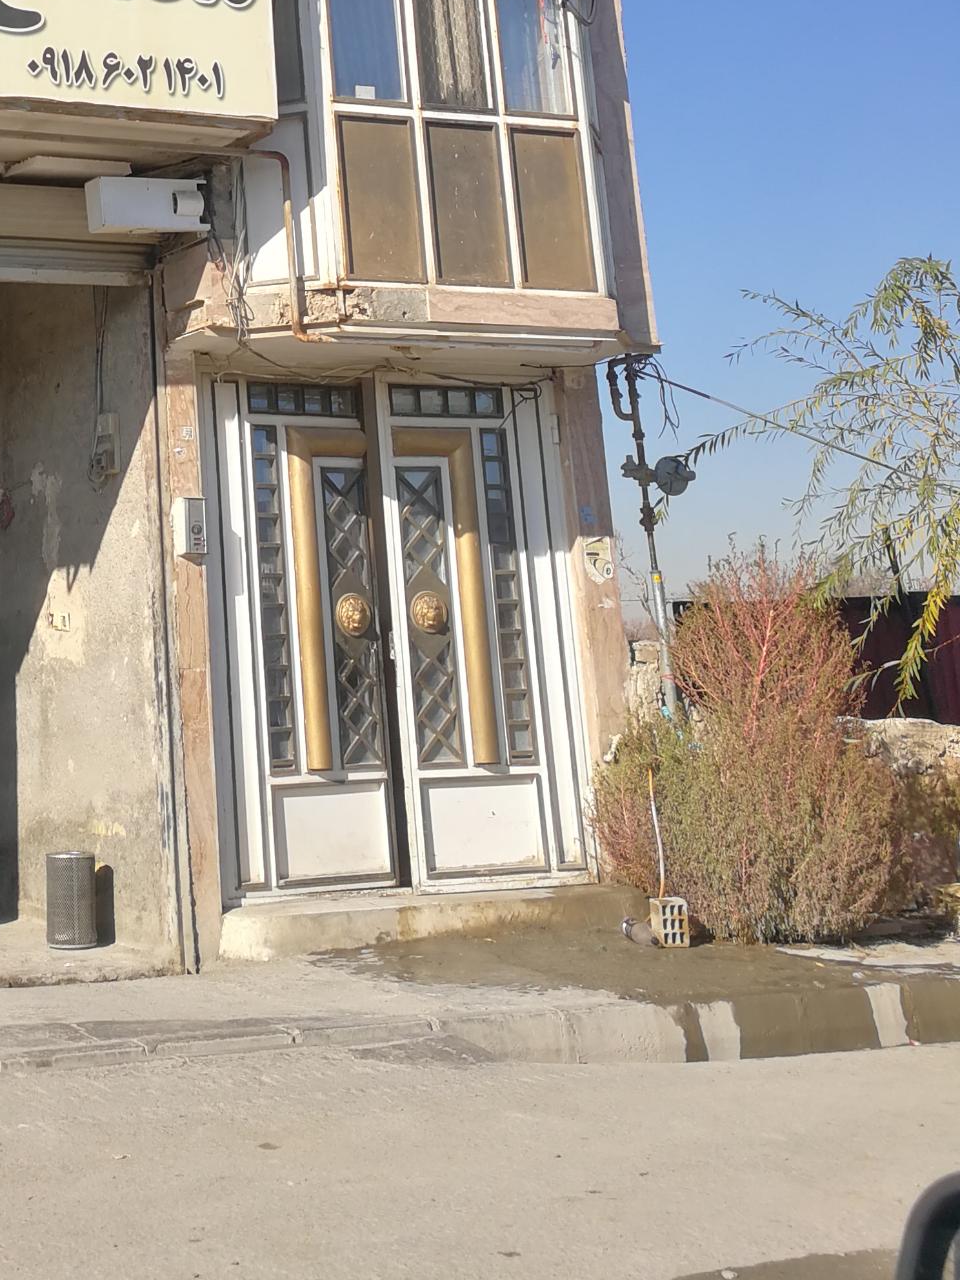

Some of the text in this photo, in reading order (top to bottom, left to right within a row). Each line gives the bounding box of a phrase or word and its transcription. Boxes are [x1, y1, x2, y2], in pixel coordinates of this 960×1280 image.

[27, 46, 224, 97] ۰۹۱۸ ۶۰۲ ۱۴۰۱
